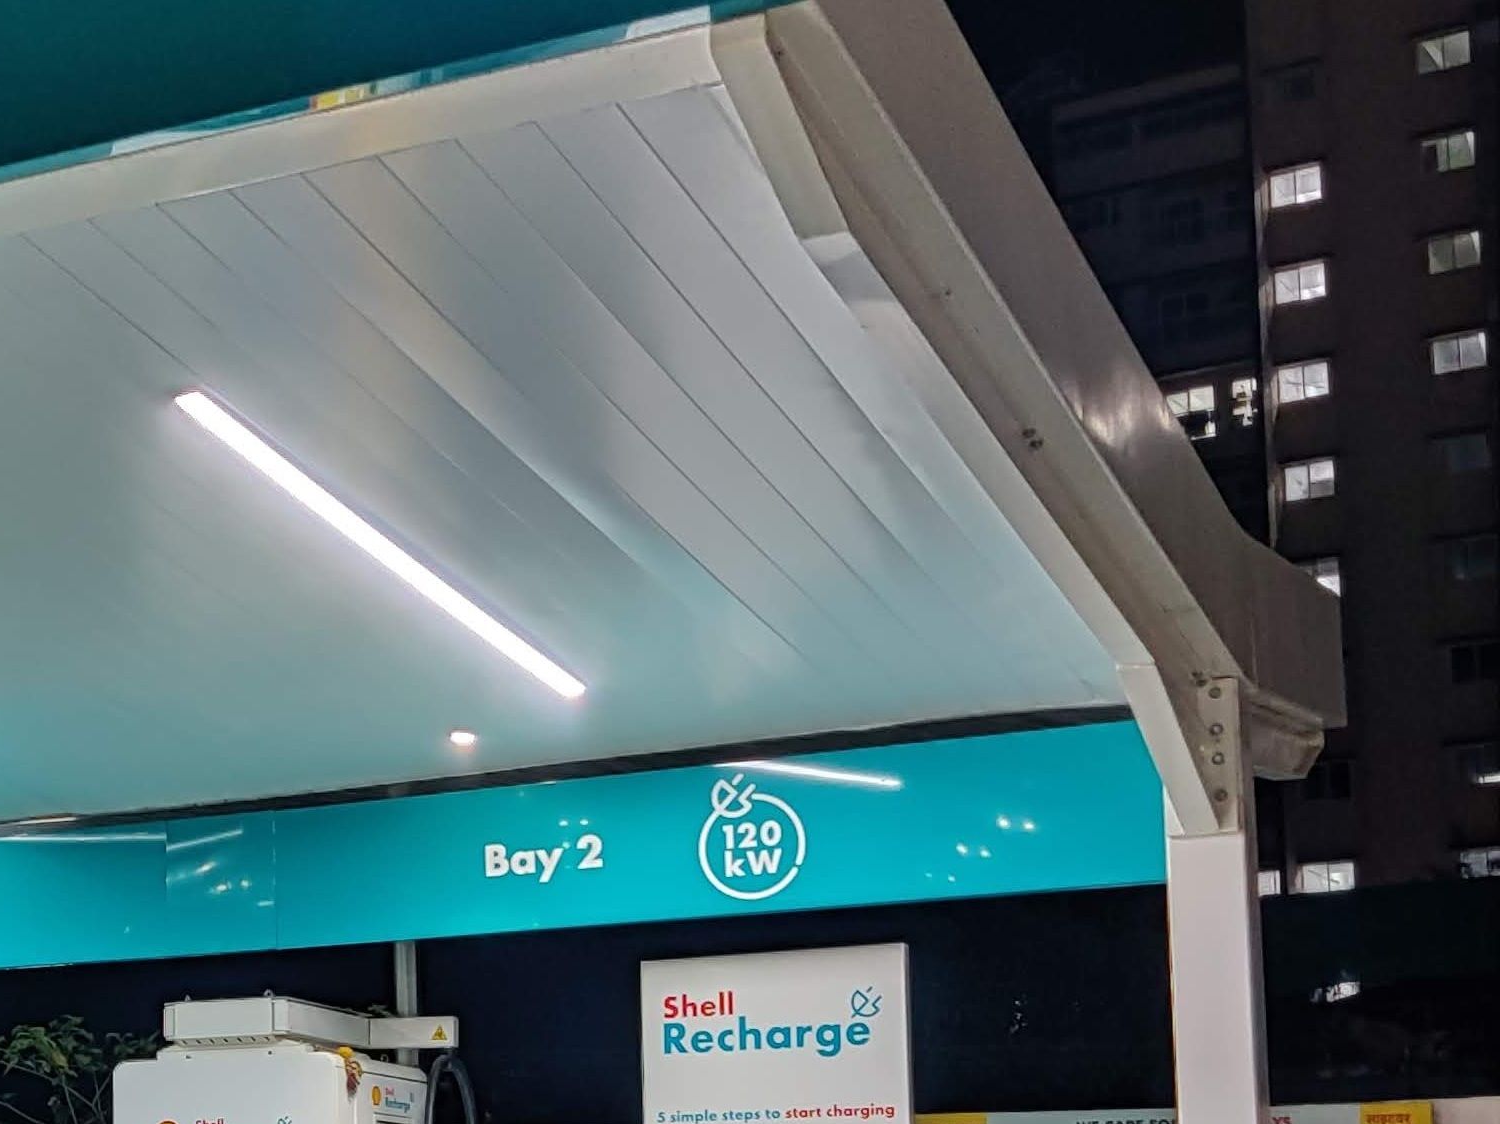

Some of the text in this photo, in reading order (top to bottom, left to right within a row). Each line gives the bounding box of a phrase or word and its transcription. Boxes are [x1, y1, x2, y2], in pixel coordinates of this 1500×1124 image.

[722, 820, 782, 850] 120
[485, 834, 604, 883] Bay 2
[724, 848, 782, 878] kW
[663, 990, 734, 1019] Shell
[663, 1016, 871, 1057] Recharge
[657, 1103, 895, 1124] 5 simple steps to start charging
